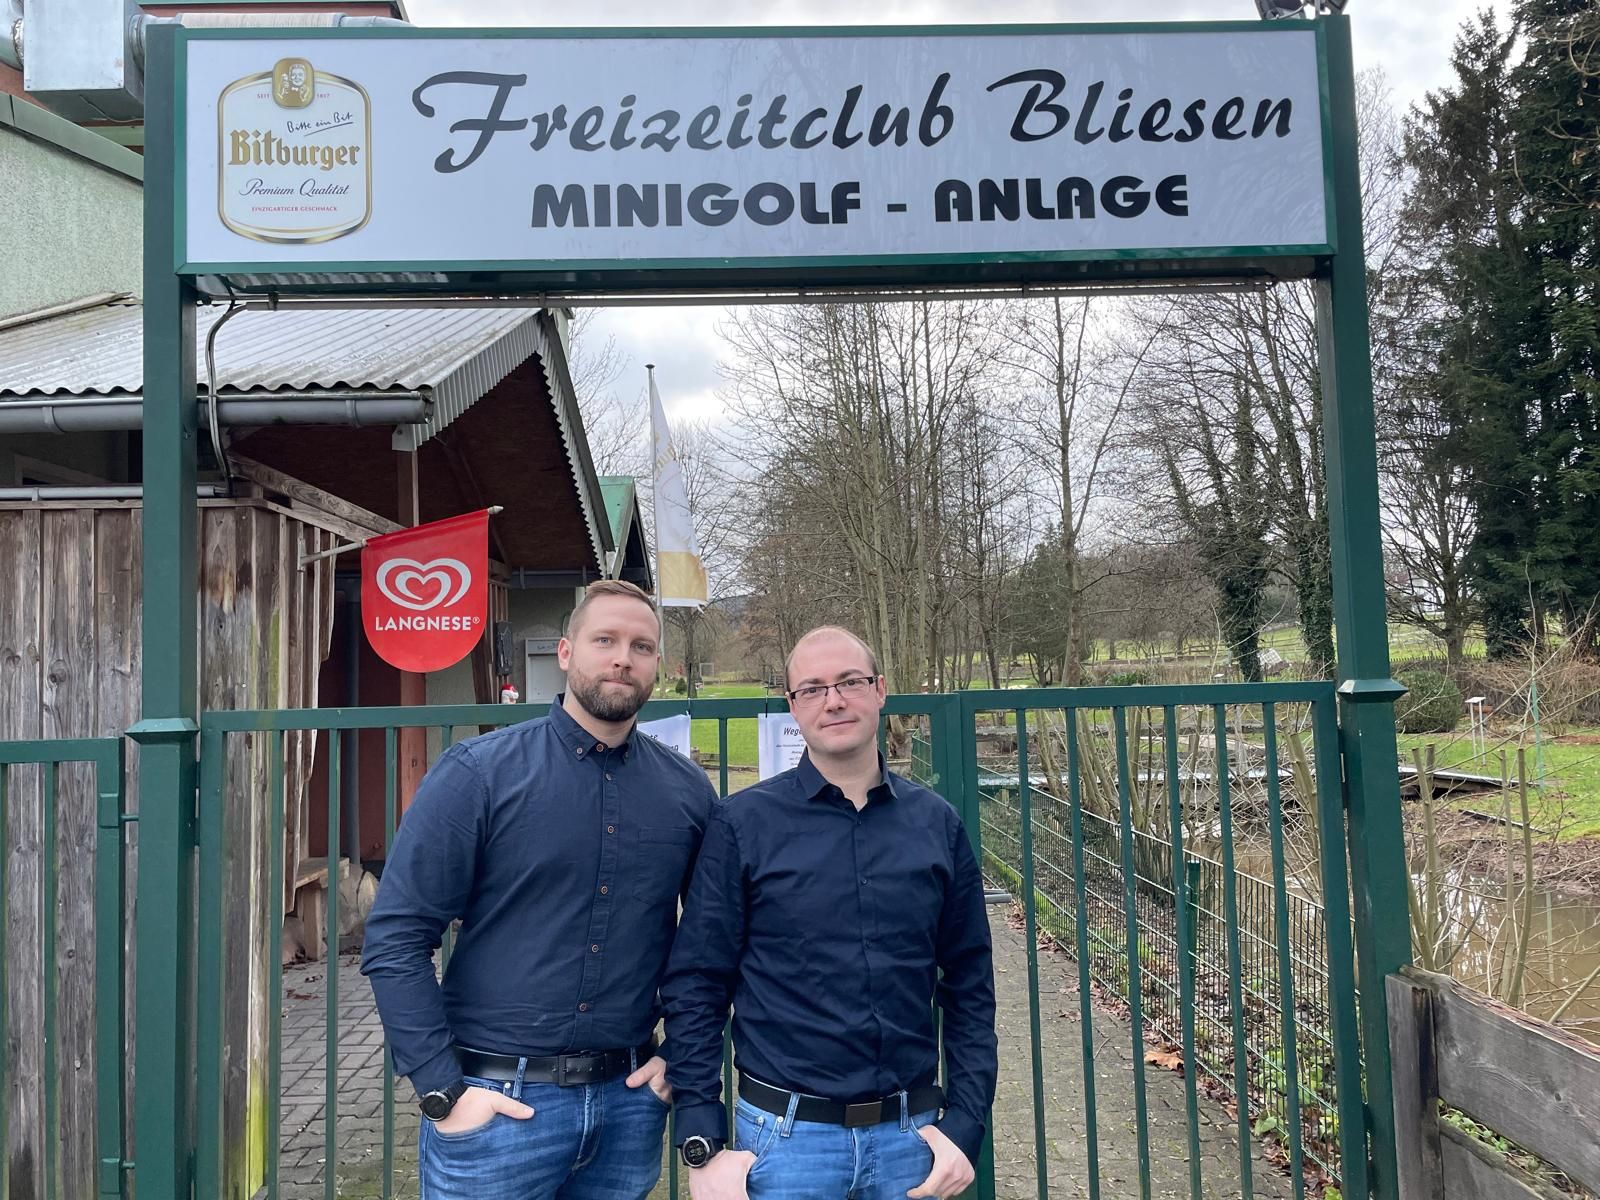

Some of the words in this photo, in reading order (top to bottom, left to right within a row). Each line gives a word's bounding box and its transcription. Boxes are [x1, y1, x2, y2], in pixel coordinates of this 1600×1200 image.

[287, 121, 312, 133] Bitte
[315, 120, 331, 128] ein
[333, 111, 353, 124] Bit
[412, 70, 954, 174] Freizeitclub
[986, 68, 1293, 146] Bliesen
[228, 129, 361, 171] Bitburger
[239, 178, 295, 196] Premium
[300, 178, 350, 197] Qualität
[531, 182, 860, 228] MINIGOLF
[887, 203, 907, 212] -
[934, 174, 1189, 222] ANLAGE
